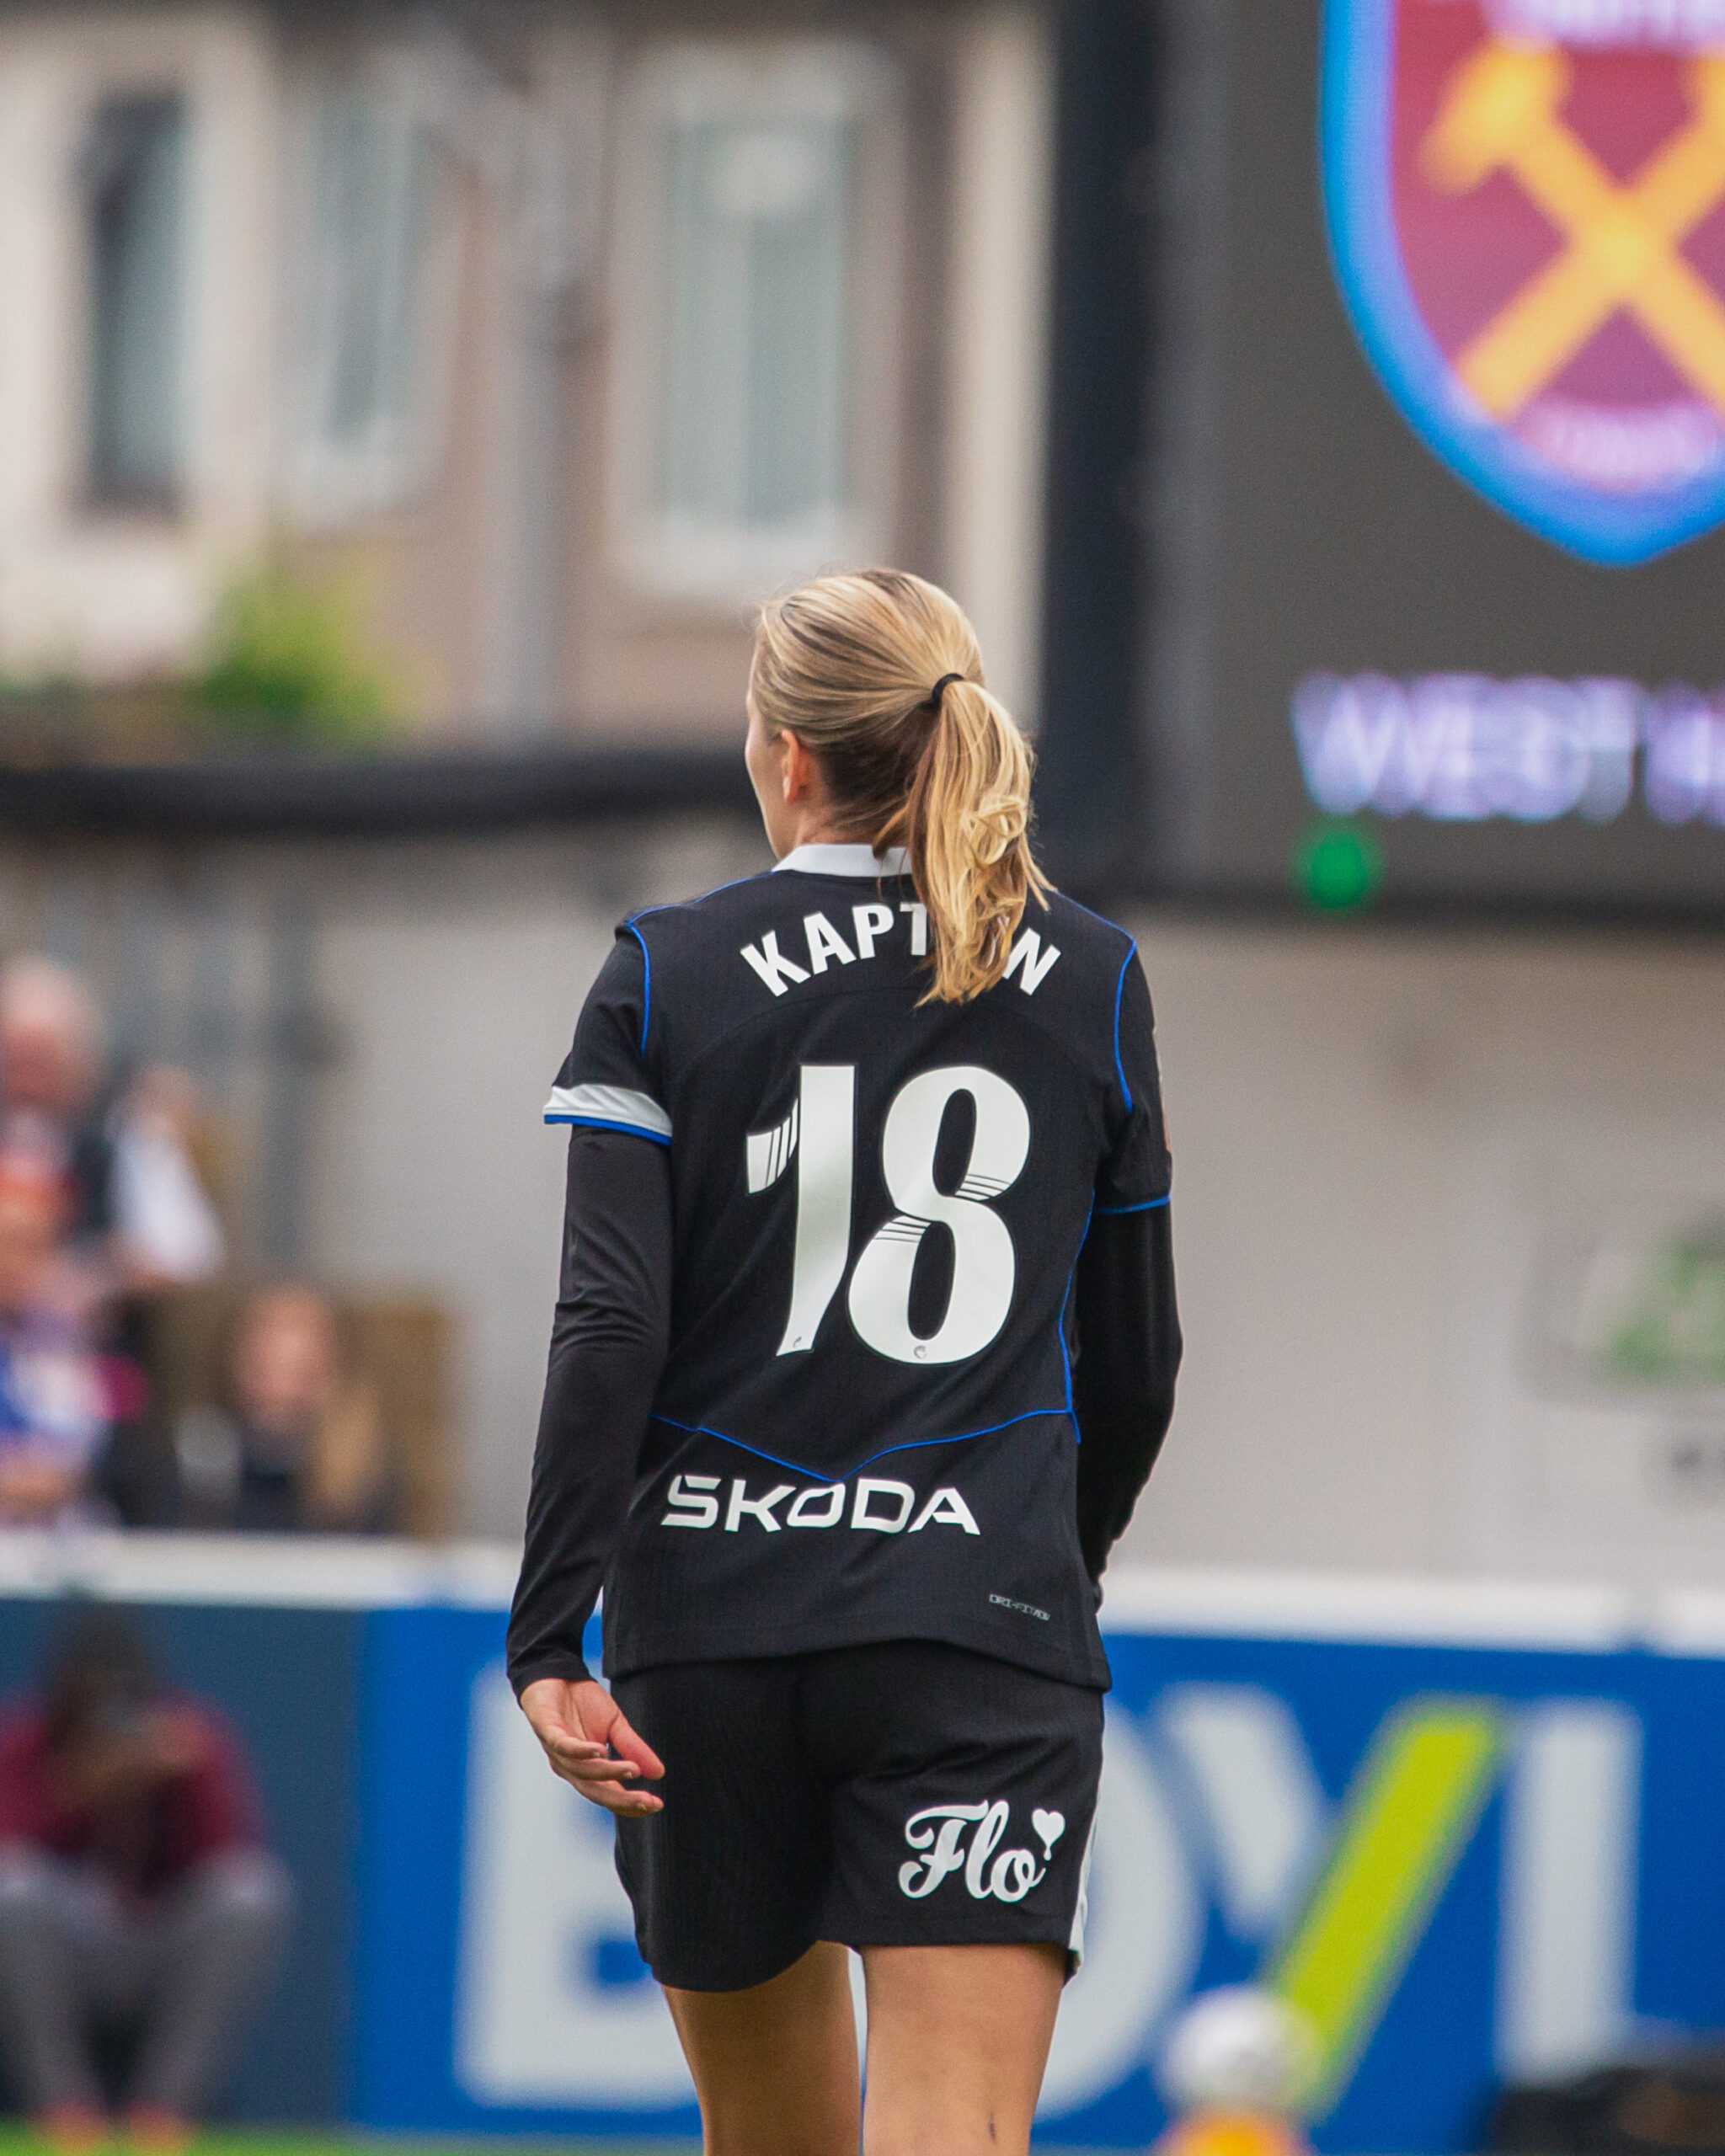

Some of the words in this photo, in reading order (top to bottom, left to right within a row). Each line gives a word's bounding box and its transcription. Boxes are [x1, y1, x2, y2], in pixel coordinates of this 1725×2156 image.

[740, 901, 1061, 997] KAPTN
[746, 1065, 1030, 1364] 18
[898, 1799, 1047, 1903] Flo
